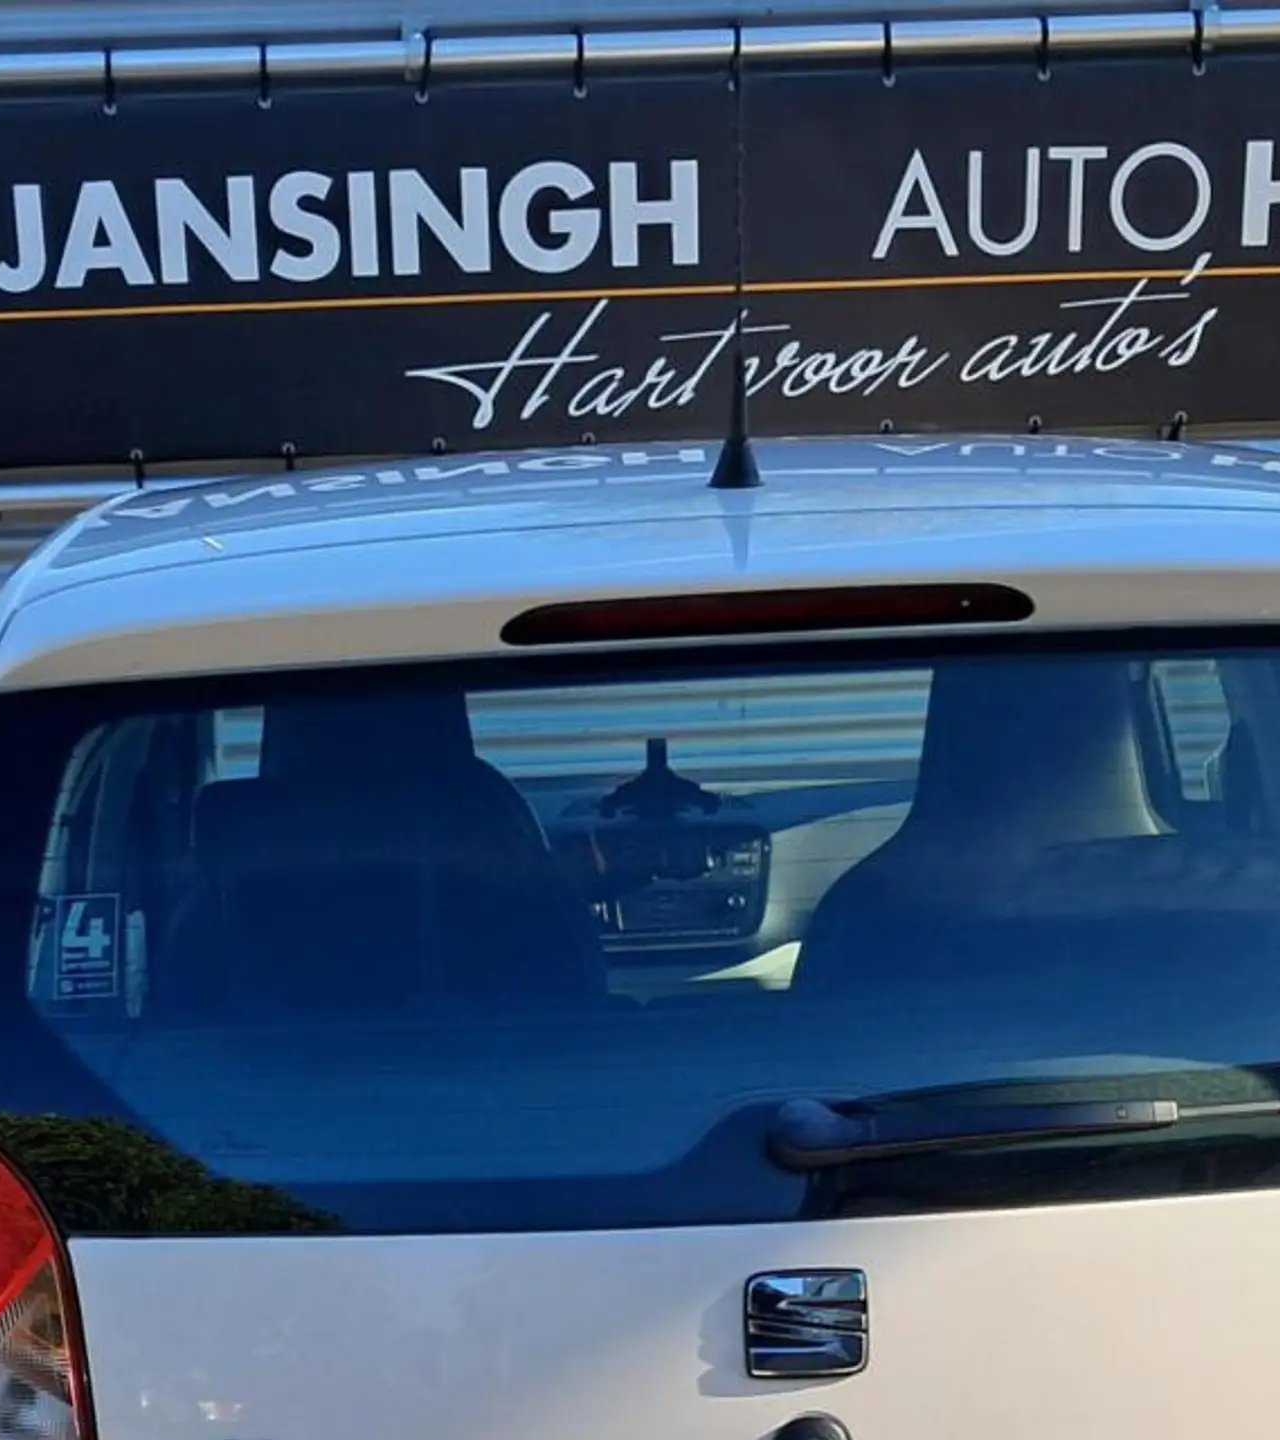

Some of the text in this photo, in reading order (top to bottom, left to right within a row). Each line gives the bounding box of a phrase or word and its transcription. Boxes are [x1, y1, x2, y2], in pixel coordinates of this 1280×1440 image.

[870, 140, 1213, 260] AUTO
[405, 251, 1219, 429] Hart voor auto's
